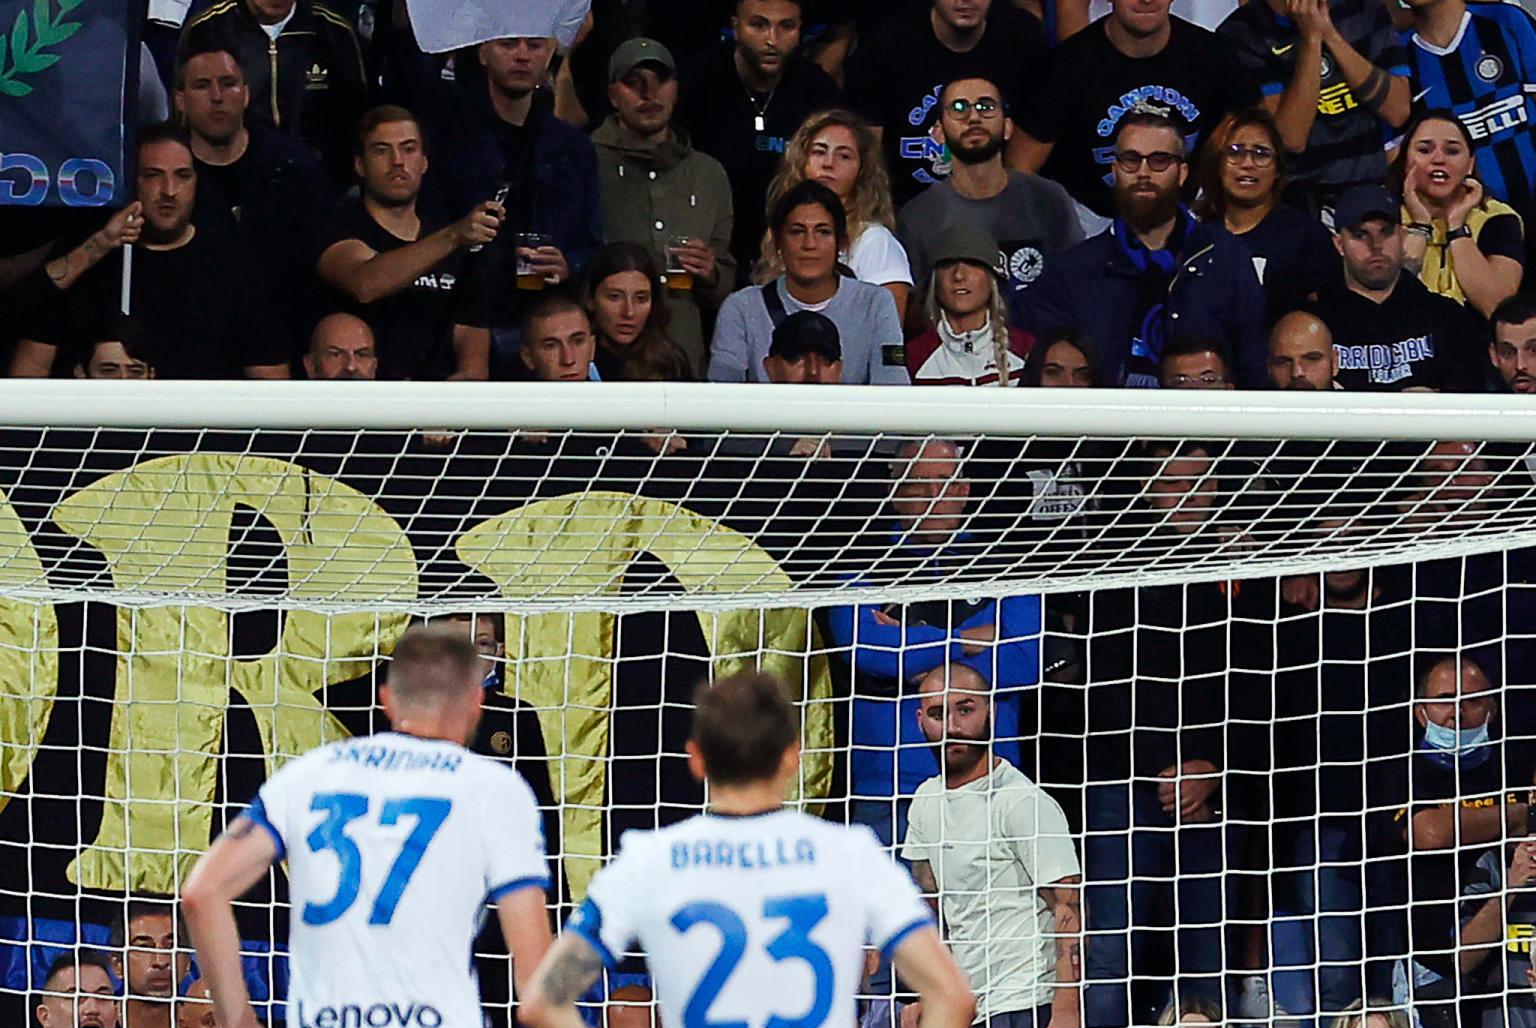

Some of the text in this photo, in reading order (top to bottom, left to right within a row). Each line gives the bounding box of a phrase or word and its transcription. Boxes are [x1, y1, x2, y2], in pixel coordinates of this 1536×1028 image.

[1466, 106, 1528, 140] ELLI
[302, 791, 453, 927] 37
[670, 840, 817, 870] BARELLA
